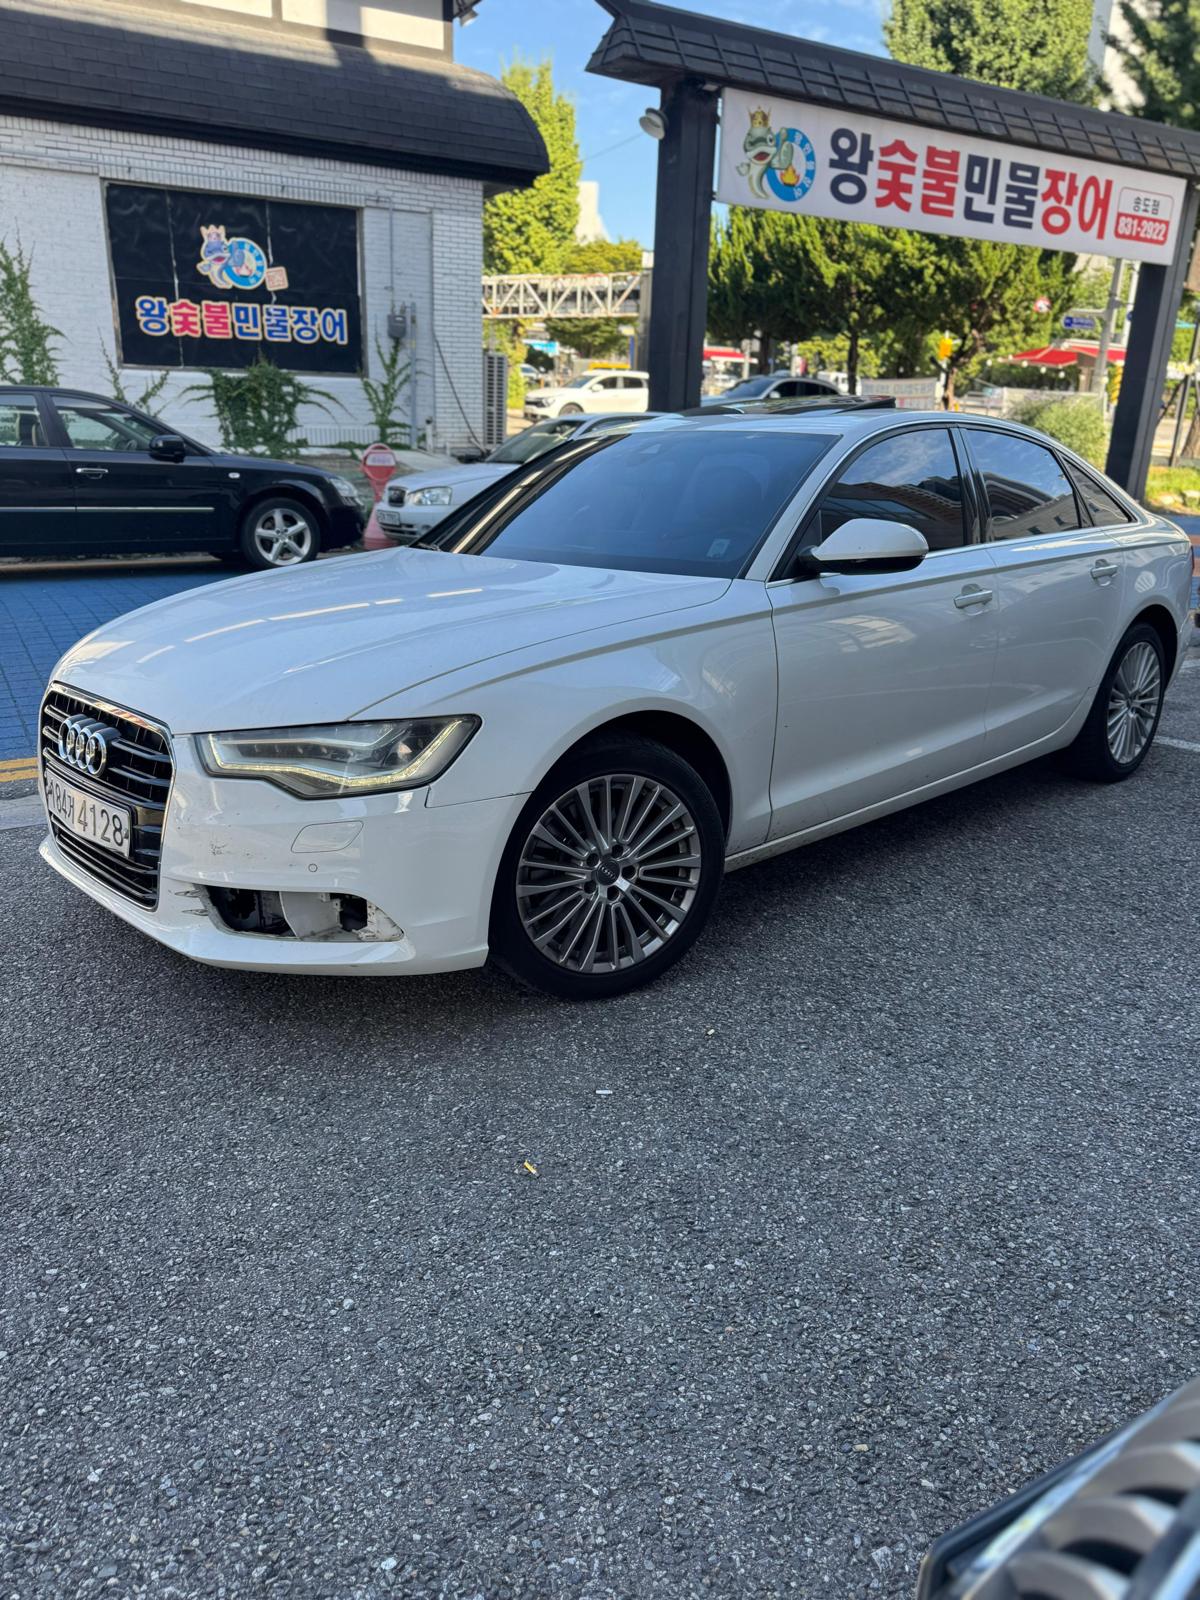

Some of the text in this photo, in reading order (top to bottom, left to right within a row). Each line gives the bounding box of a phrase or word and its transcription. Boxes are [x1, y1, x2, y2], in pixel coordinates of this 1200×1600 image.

[1133, 196, 1160, 215] 송도점
[1117, 215, 1167, 241] 831-2922
[77, 799, 124, 847] 4128
